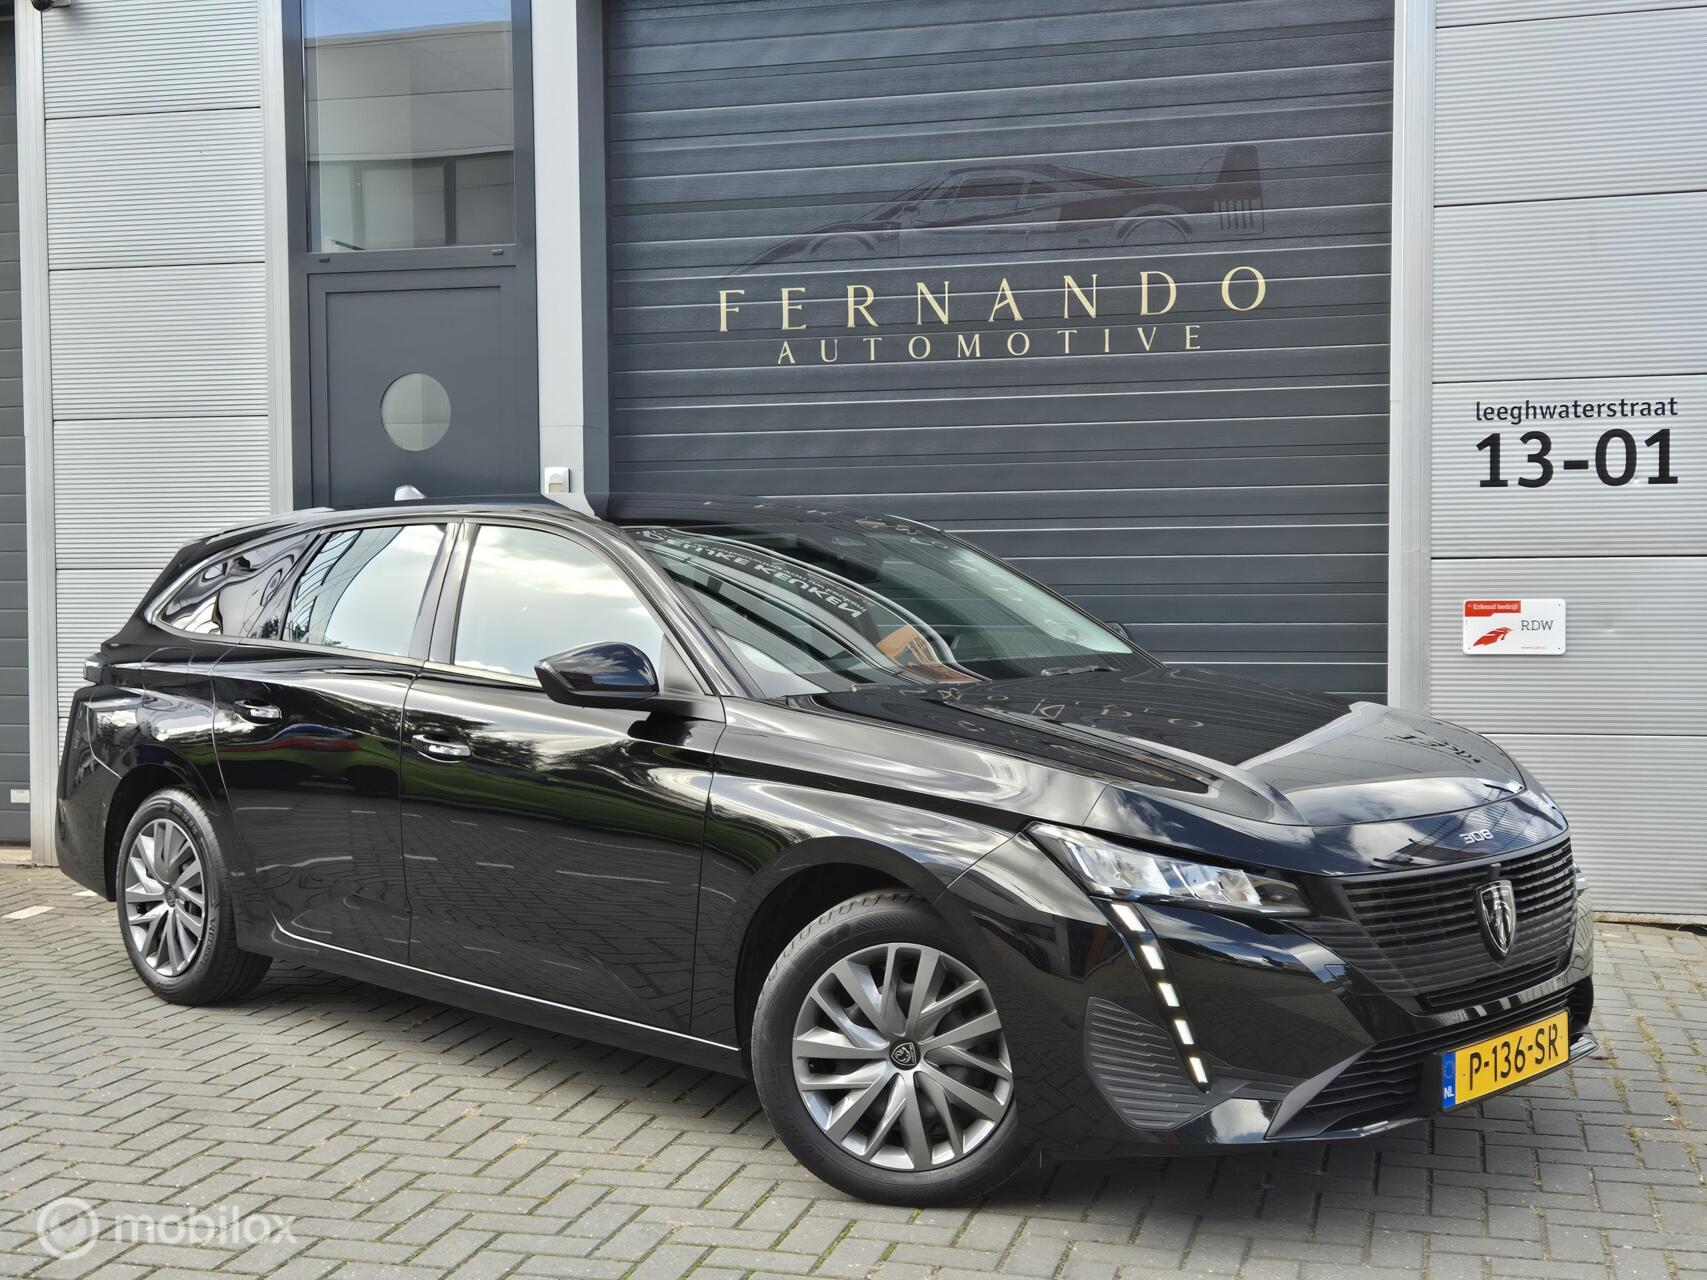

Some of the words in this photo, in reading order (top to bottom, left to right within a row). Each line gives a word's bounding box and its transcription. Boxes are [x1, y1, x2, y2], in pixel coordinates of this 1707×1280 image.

[718, 265, 1268, 333] FERNANDO
[777, 324, 1202, 366] AUTOMOTIVE
[1475, 397, 1679, 425] leeghwaterstraat
[1475, 427, 1679, 488] 13-01
[1520, 619, 1554, 632] RDW
[1459, 828, 1494, 844] 308
[1468, 1022, 1559, 1092] P-136-SR
[1443, 1085, 1455, 1099] NL
